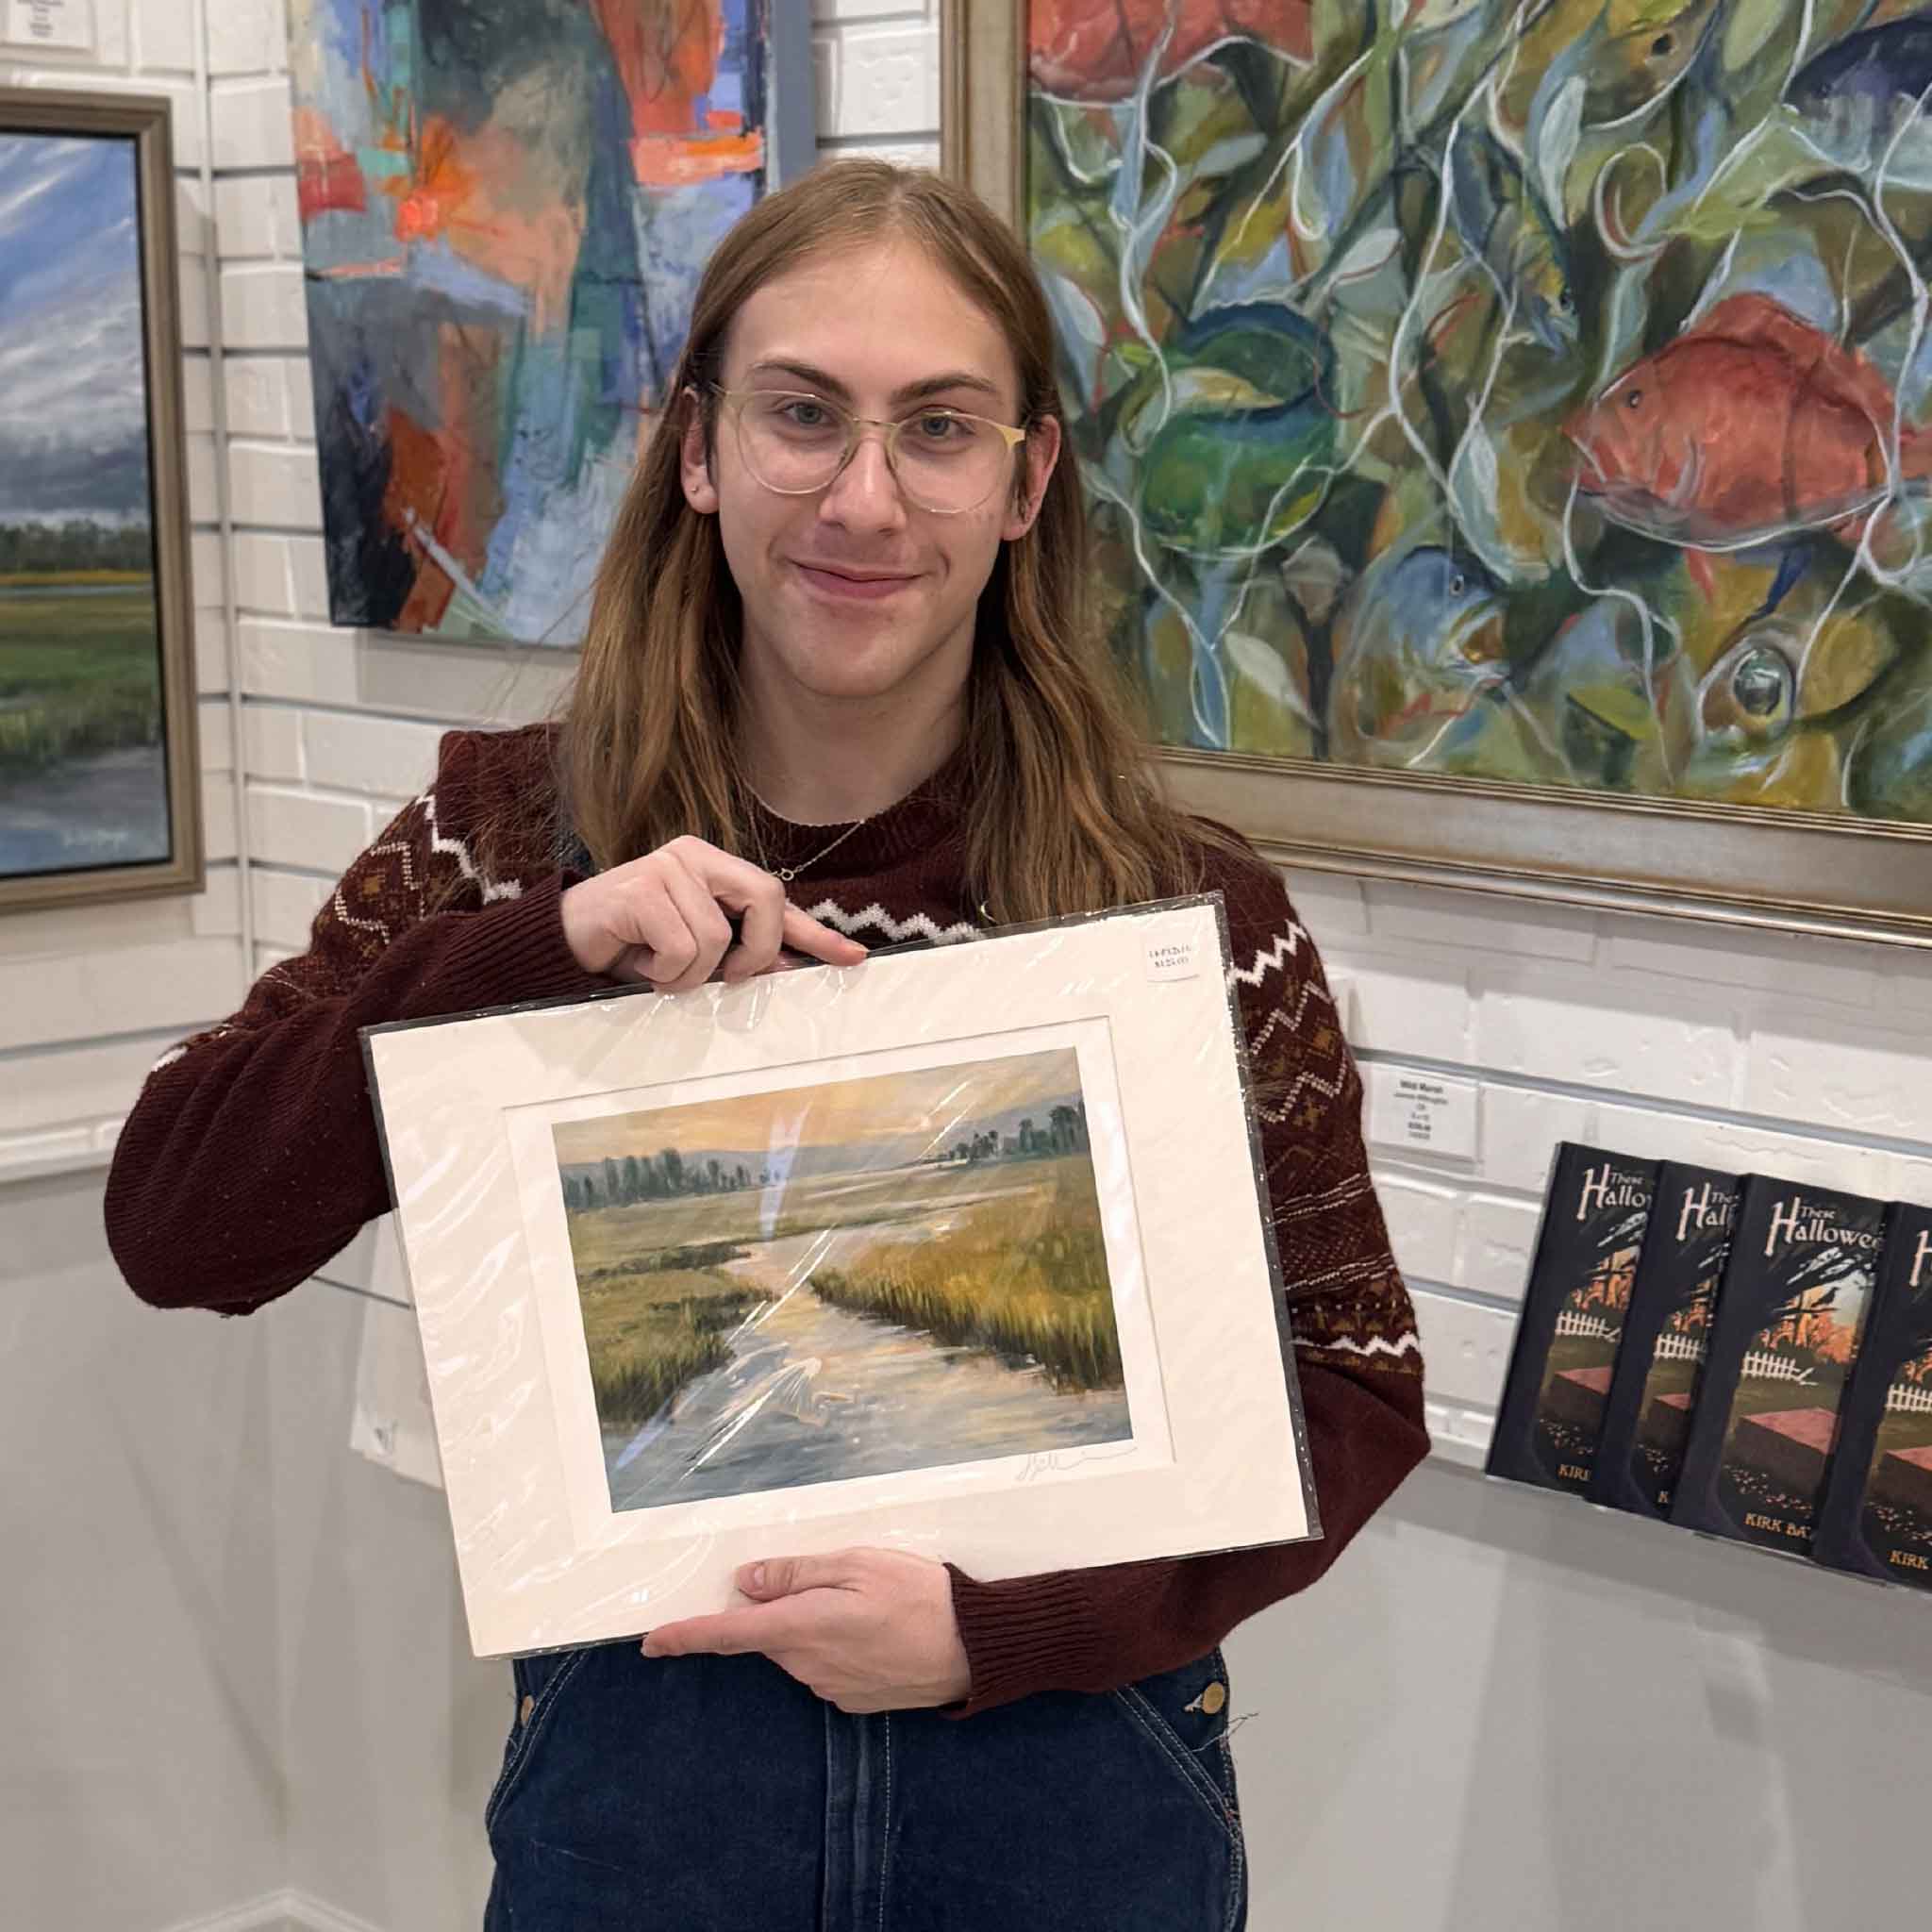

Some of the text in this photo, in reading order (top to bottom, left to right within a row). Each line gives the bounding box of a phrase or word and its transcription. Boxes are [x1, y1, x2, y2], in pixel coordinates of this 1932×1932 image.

[1577, 1163, 1652, 1221] Hallo
[1800, 1206, 1836, 1220] These
[1745, 1512, 1782, 1532] KIRK
[1890, 1550, 1929, 1570] KIRK
